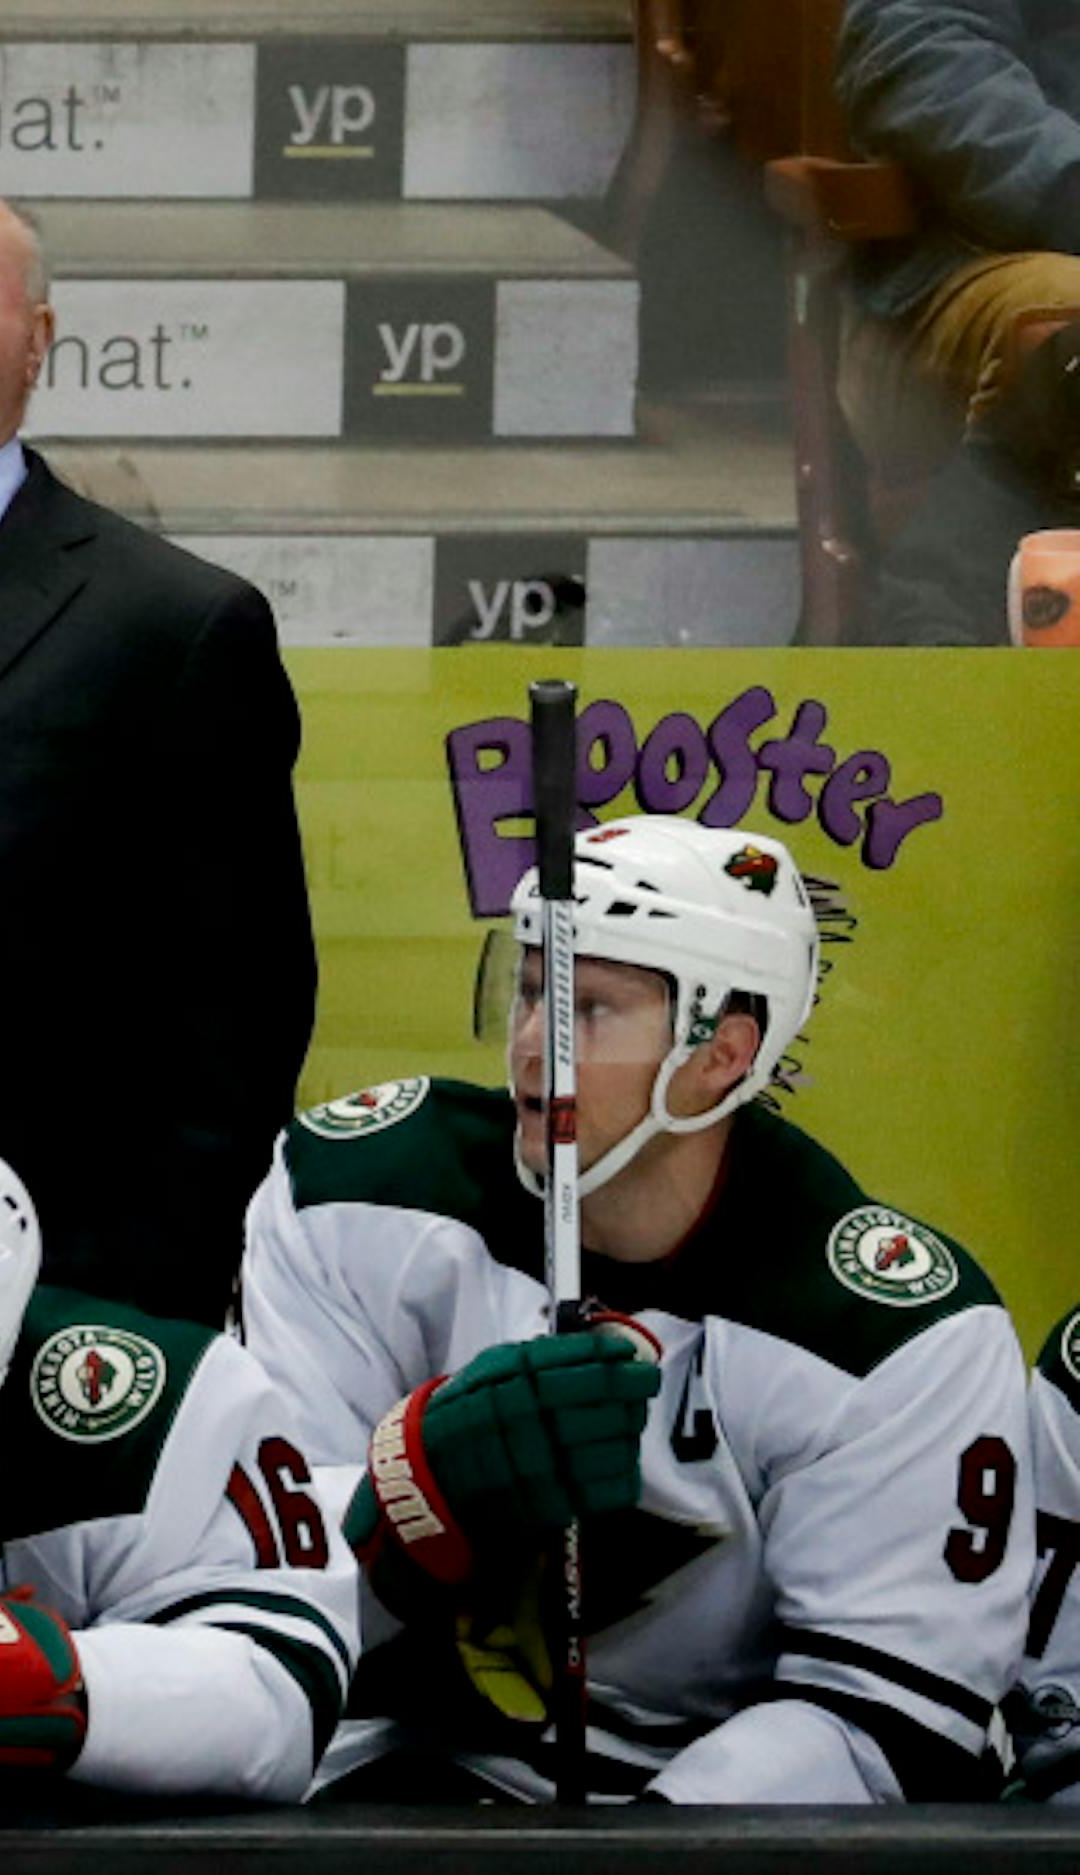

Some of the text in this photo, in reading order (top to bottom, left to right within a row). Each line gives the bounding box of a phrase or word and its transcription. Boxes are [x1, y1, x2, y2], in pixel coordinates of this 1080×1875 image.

[289, 83, 375, 144] yp
[378, 320, 465, 382] yp
[468, 577, 556, 639] yp
[445, 685, 943, 919] Booster
[223, 1436, 329, 1571] 16
[942, 1434, 1018, 1585] 9
